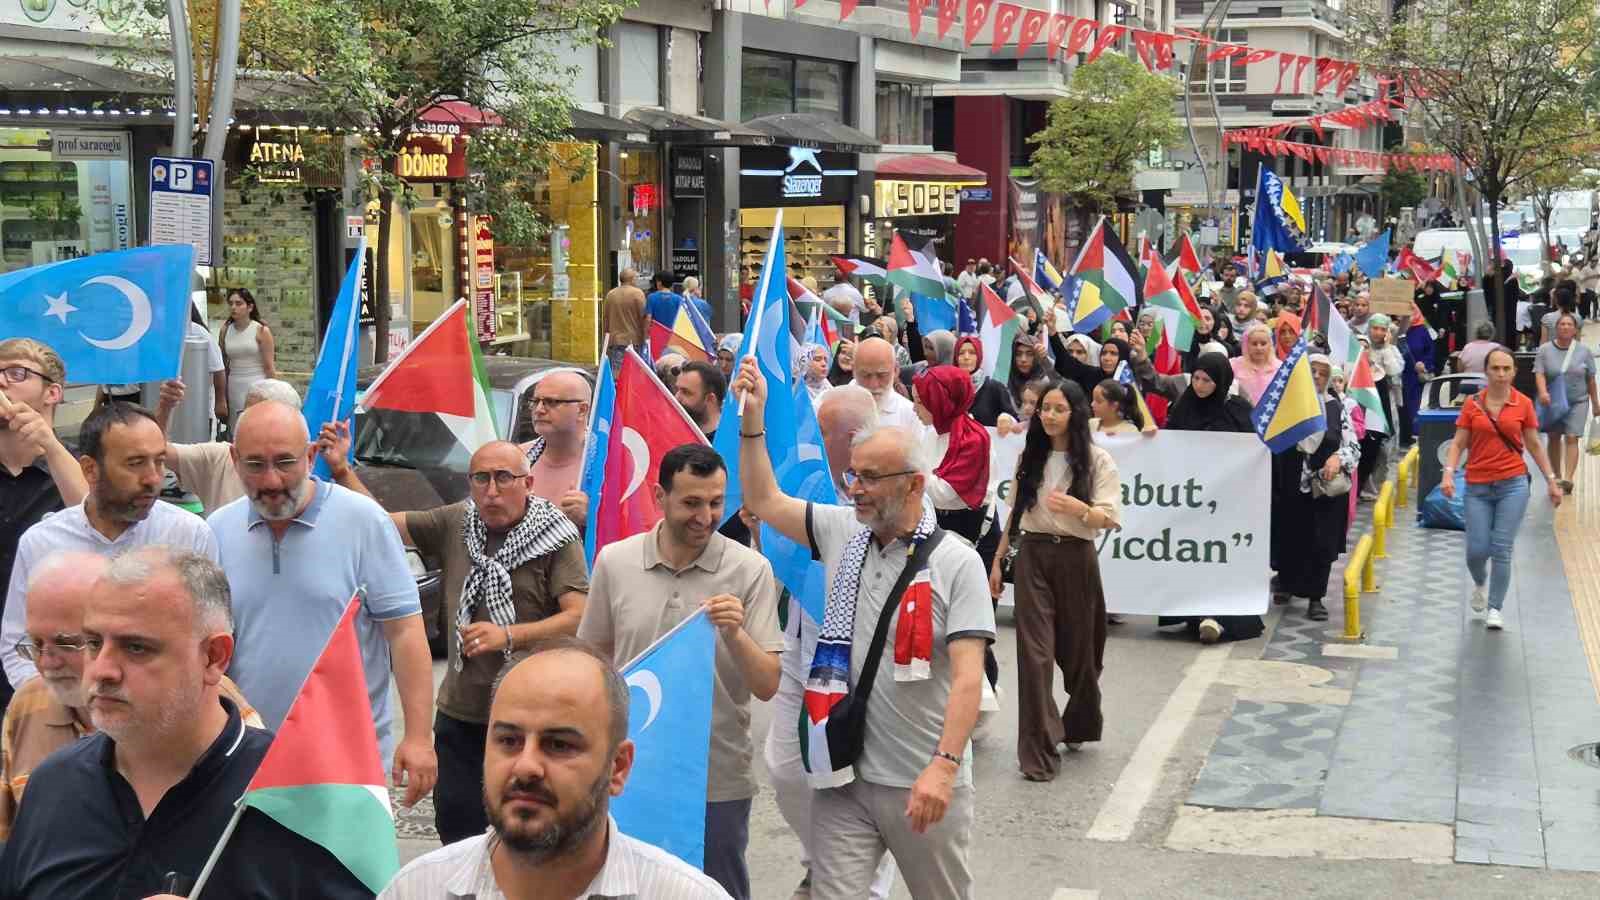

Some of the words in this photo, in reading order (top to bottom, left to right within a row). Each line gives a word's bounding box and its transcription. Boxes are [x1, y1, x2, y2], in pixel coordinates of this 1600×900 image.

[57, 138, 78, 154] prof
[402, 146, 448, 177] DÖNER
[175, 167, 188, 186] P
[897, 183, 956, 215] SOBE
[1120, 472, 1217, 515] abut,
